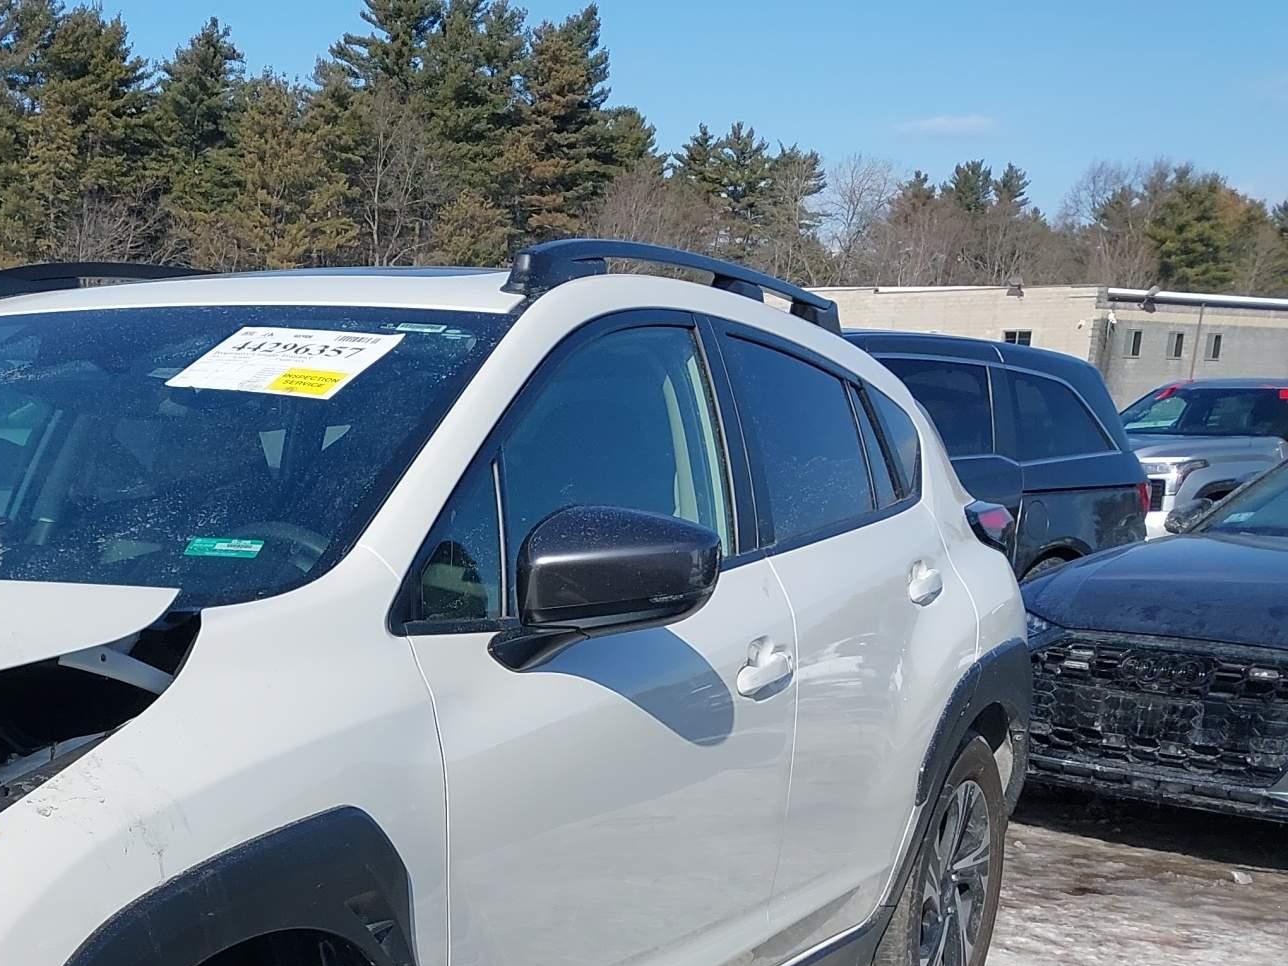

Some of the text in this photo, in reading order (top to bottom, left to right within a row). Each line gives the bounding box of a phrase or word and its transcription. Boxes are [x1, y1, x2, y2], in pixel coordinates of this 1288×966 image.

[231, 340, 365, 358] 44296357
[282, 373, 341, 384] INSPECTION
[282, 379, 326, 388] SERVICE
